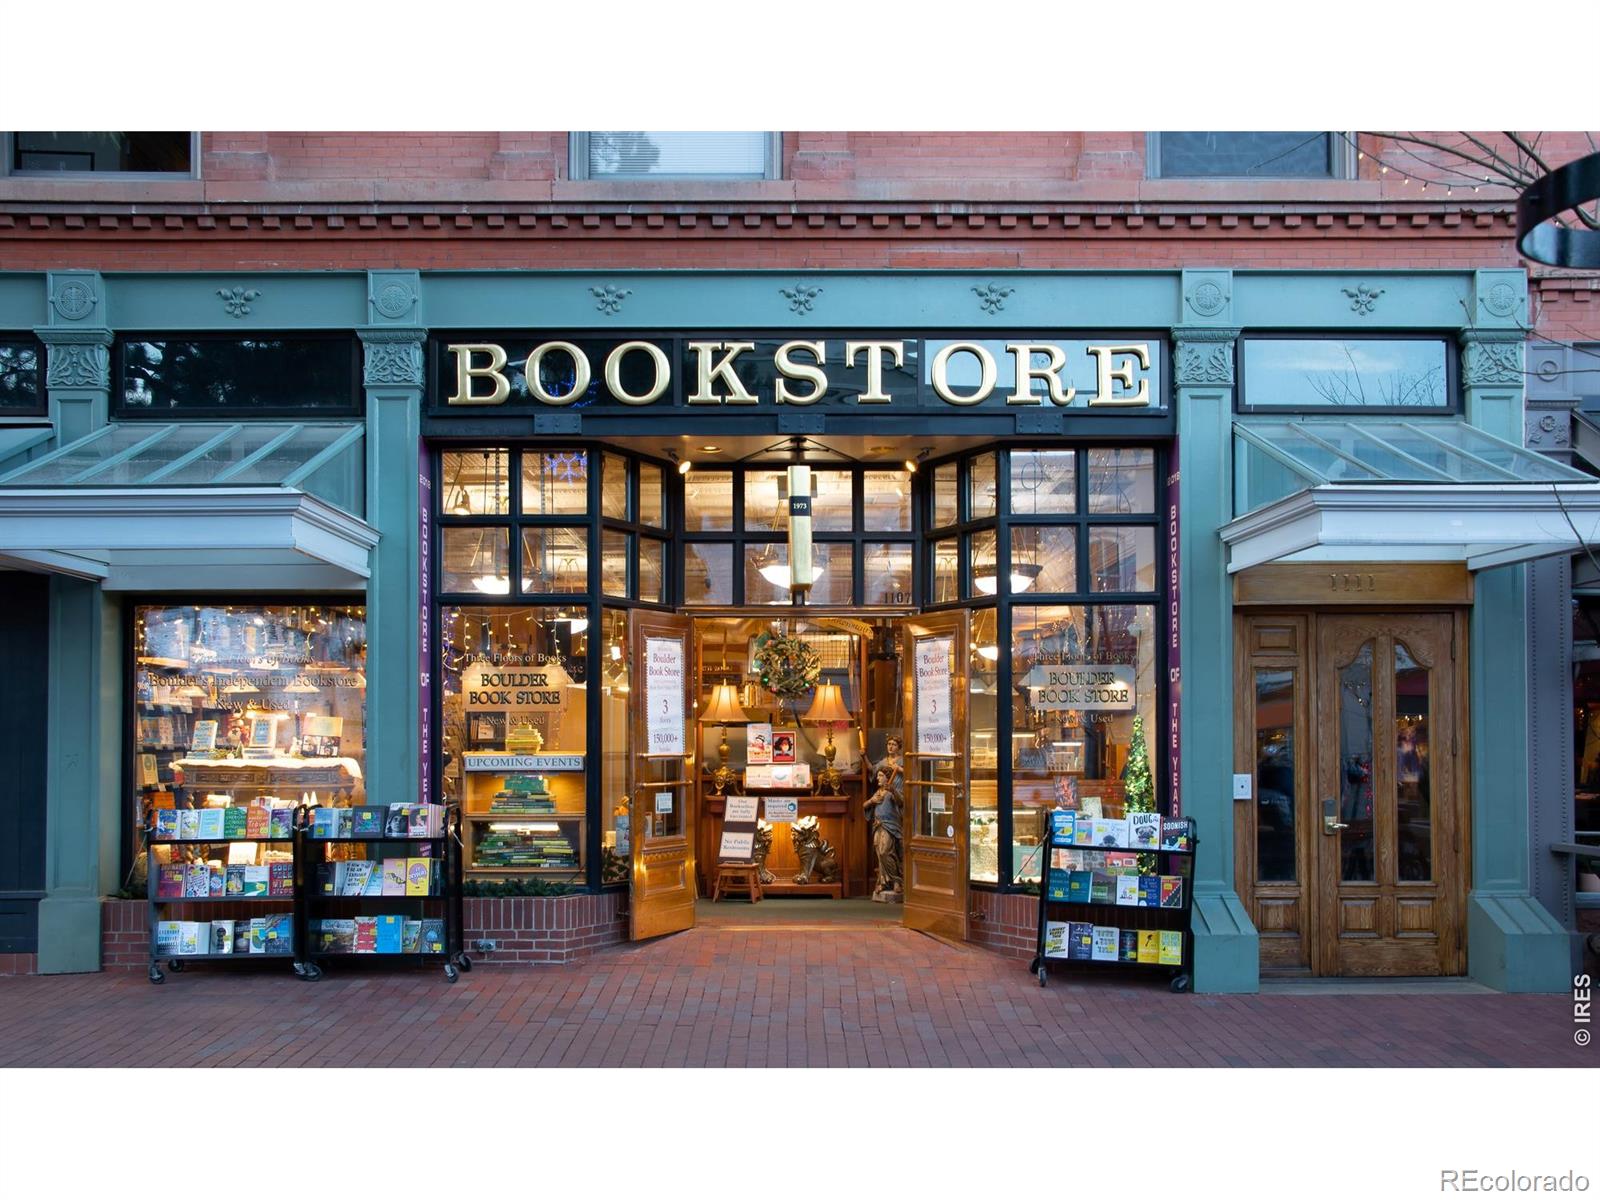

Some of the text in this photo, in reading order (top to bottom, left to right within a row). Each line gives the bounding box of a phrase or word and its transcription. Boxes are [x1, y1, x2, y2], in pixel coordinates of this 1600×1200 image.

[447, 340, 1151, 406] BOOKSTORE
[793, 502, 807, 510] 1973
[421, 507, 430, 653] BOOKSTORE
[1170, 504, 1178, 648] BOOKSTORE
[884, 591, 911, 604] 1107
[465, 653, 567, 663] Three Floors of Books
[653, 653, 676, 664] Boulder
[649, 665, 680, 677] Book Store
[919, 667, 934, 678] Book
[1170, 667, 1180, 683] OF
[148, 672, 208, 688] Boulder's
[293, 672, 358, 688] Bookstore
[421, 672, 430, 687] OF
[481, 673, 549, 687] BOULDER
[1049, 671, 1116, 686] BOULDER
[469, 691, 560, 705] BOOK STORE
[1038, 689, 1129, 704] BOOK STORE
[215, 698, 244, 711] New
[249, 698, 260, 711] &
[662, 698, 669, 714] 3
[930, 699, 937, 714] 3
[1090, 713, 1113, 723] Used
[421, 707, 429, 755] THE
[653, 733, 678, 745] 150,000+
[923, 733, 947, 744] 150,000+
[468, 757, 581, 767] UPCOMING EVENTS
[1171, 757, 1179, 818] YEAR
[1133, 814, 1153, 825] DOUG
[1163, 821, 1188, 830] SOONISH
